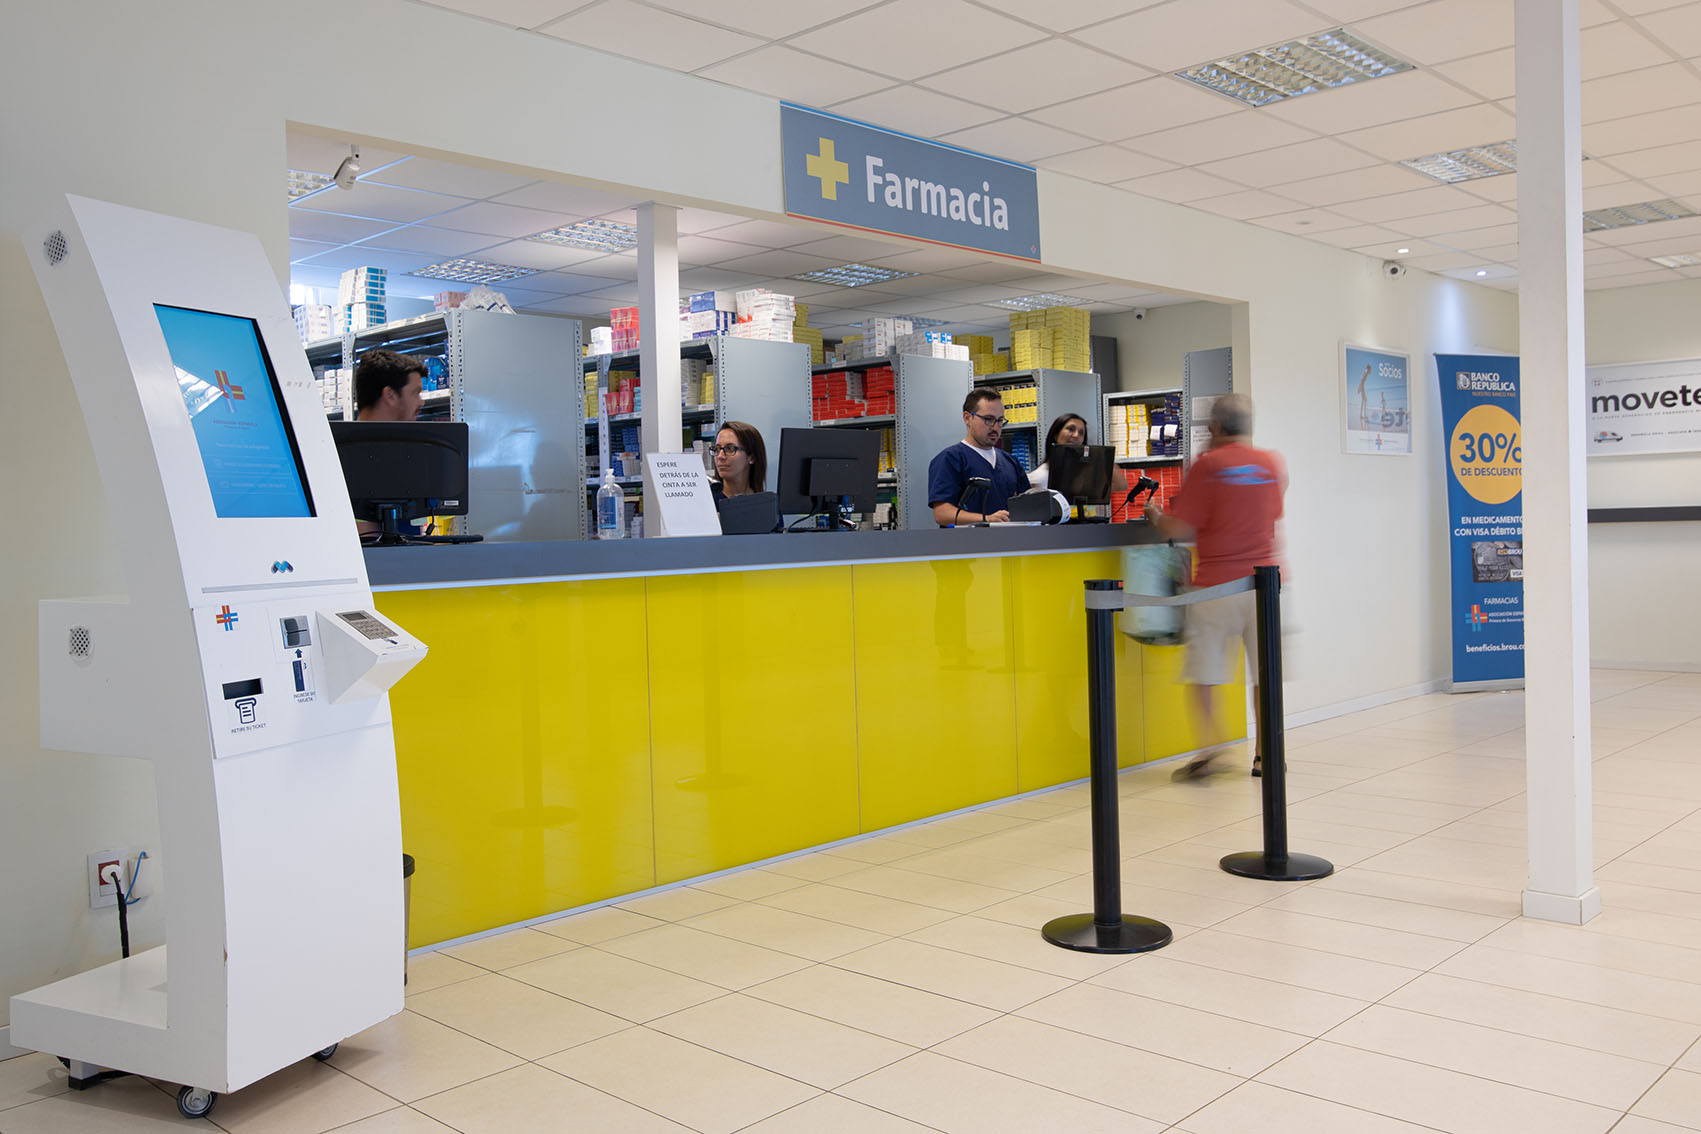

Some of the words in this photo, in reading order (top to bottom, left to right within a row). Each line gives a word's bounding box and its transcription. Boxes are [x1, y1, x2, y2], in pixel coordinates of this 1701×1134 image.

[865, 154, 1009, 231] Farmacia
[1379, 362, 1402, 379] Socios
[1471, 372, 1500, 381] BANCO
[1459, 432, 1522, 463] 30%
[1461, 467, 1472, 476] DE
[1461, 516, 1471, 524] EN
[1454, 528, 1472, 536] CON
[1473, 528, 1490, 536] VISA
[1491, 526, 1516, 535] DÉBITO
[1484, 597, 1519, 605] FARMACIAS
[231, 726, 246, 734] RETIRE
